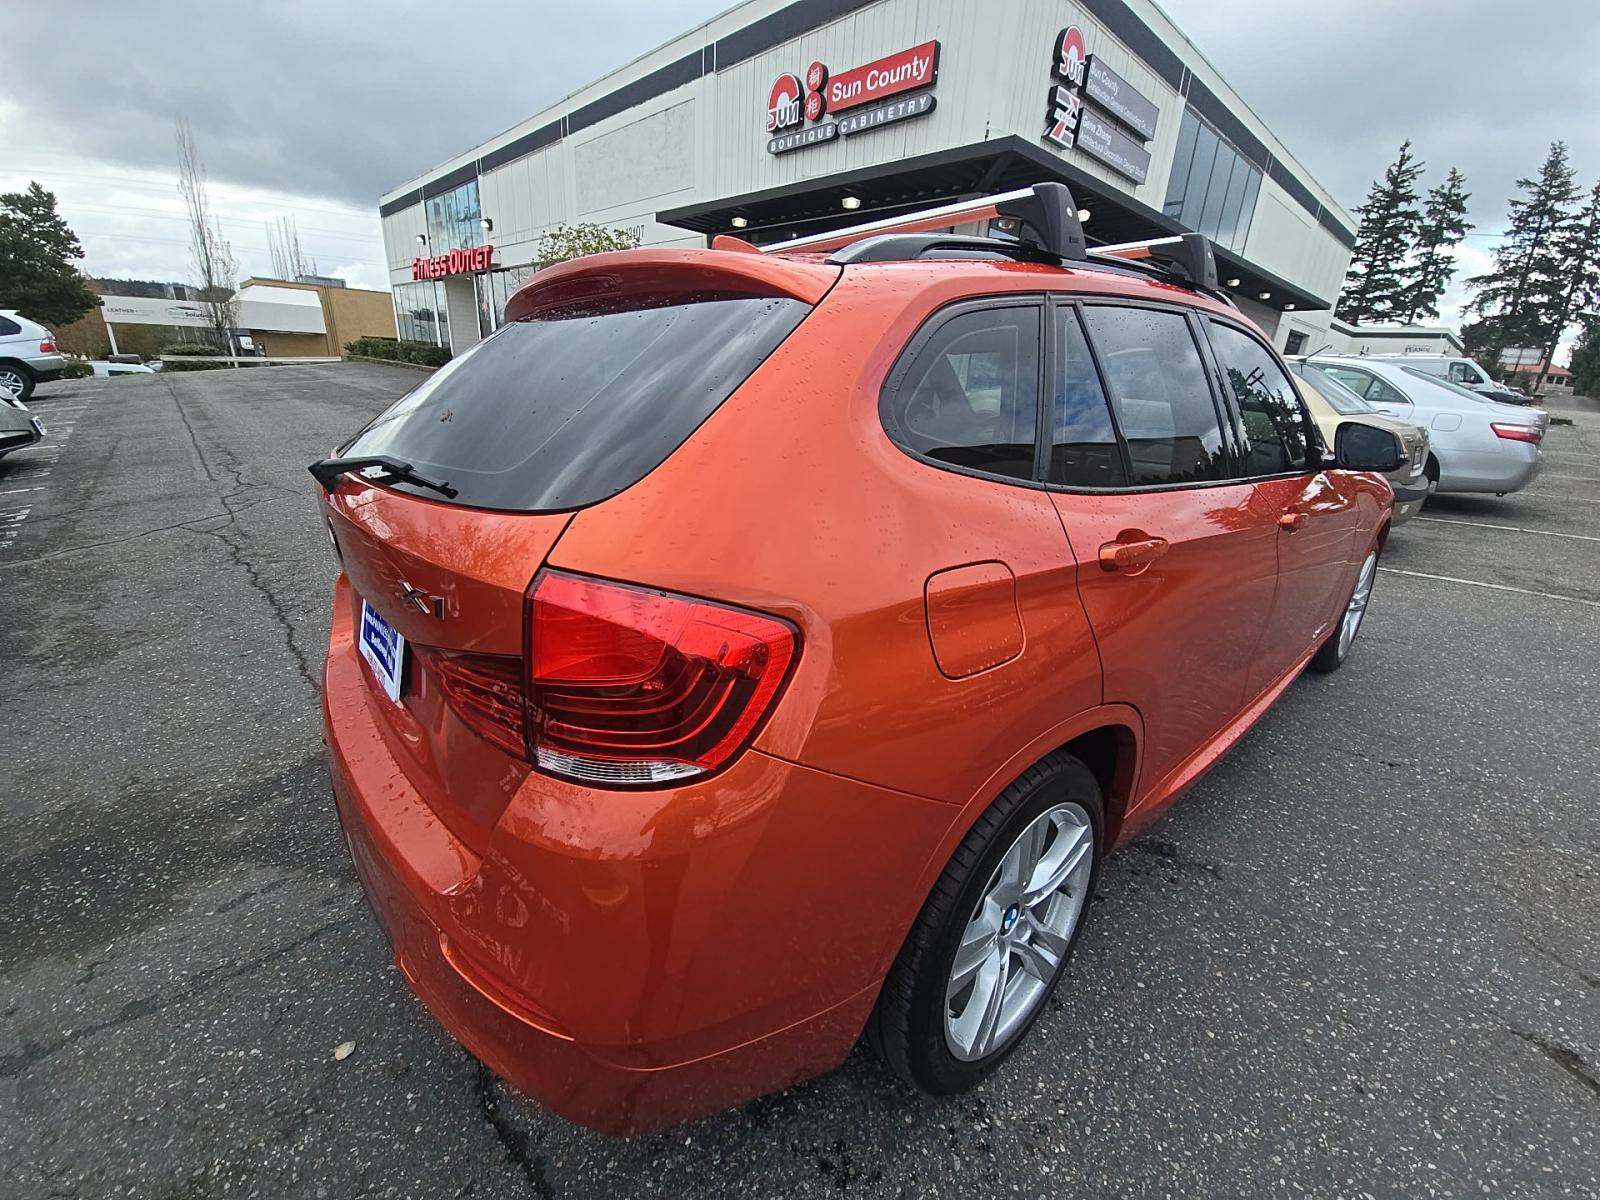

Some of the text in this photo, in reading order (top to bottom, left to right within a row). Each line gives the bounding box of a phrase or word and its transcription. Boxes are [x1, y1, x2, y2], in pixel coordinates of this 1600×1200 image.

[832, 55, 930, 103] Sun County
[770, 97, 927, 151] BOUTIQUE CABINETRY
[412, 246, 491, 281] FITNESS OUTLET
[397, 580, 444, 620] X1
